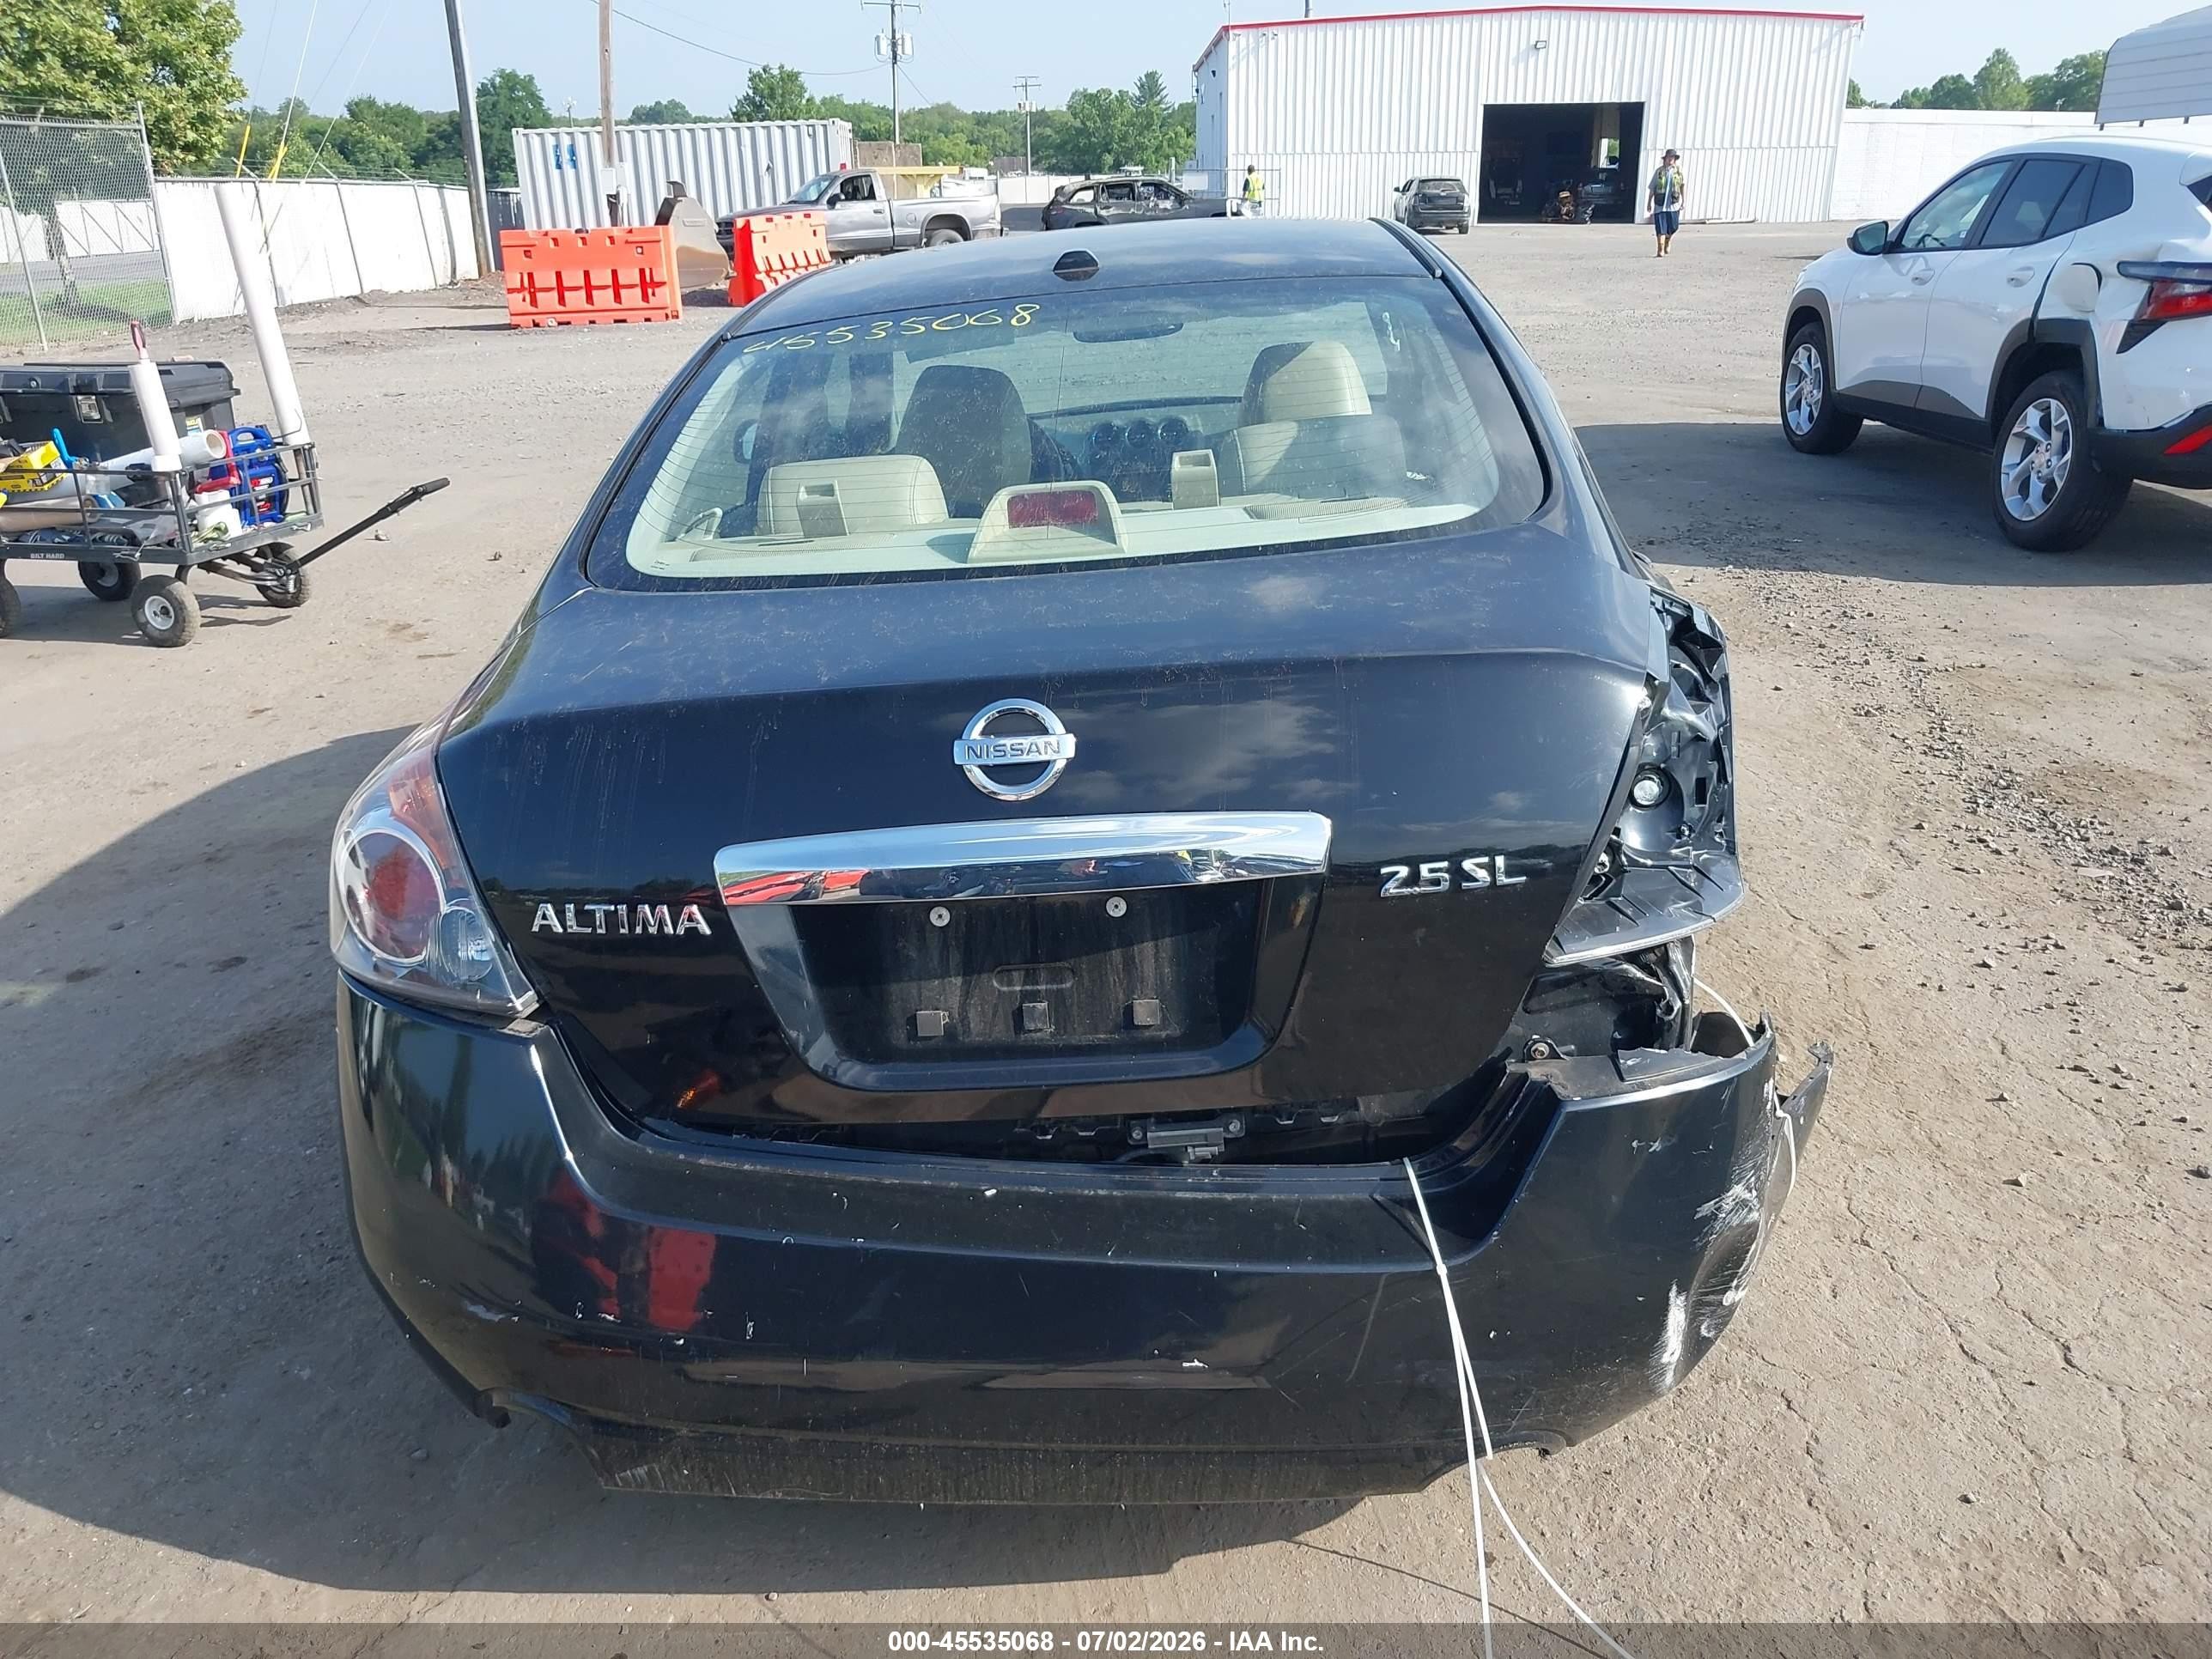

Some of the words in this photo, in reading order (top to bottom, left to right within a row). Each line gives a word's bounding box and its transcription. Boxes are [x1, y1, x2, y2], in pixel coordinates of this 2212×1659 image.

[742, 303, 1041, 353] 45535068
[964, 739, 1060, 760] NISSAN
[1462, 855, 1527, 890] SL
[531, 902, 712, 935] ALTIMA
